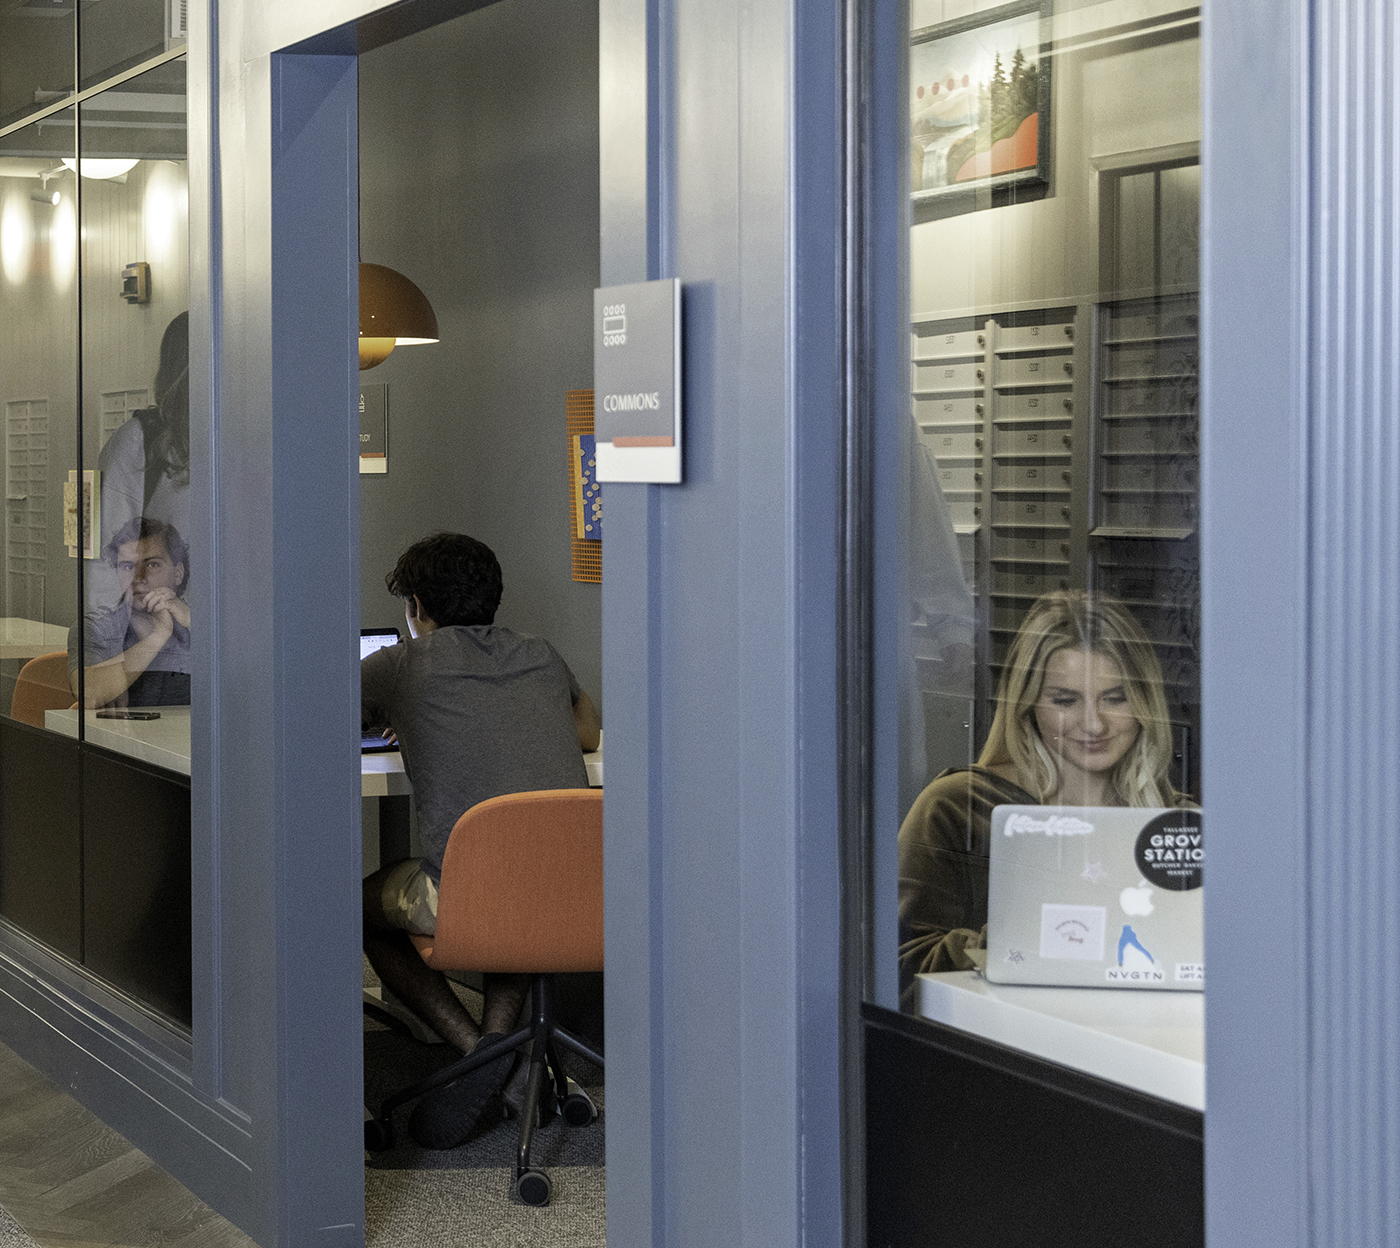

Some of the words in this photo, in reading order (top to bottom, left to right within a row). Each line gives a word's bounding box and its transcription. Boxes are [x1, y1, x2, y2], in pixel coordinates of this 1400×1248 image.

[603, 391, 660, 413] COMMONS
[359, 433, 371, 442] TUDY
[1150, 834, 1202, 847] GROV
[1144, 848, 1204, 861] STATIO
[1108, 971, 1163, 980] NVGTN
